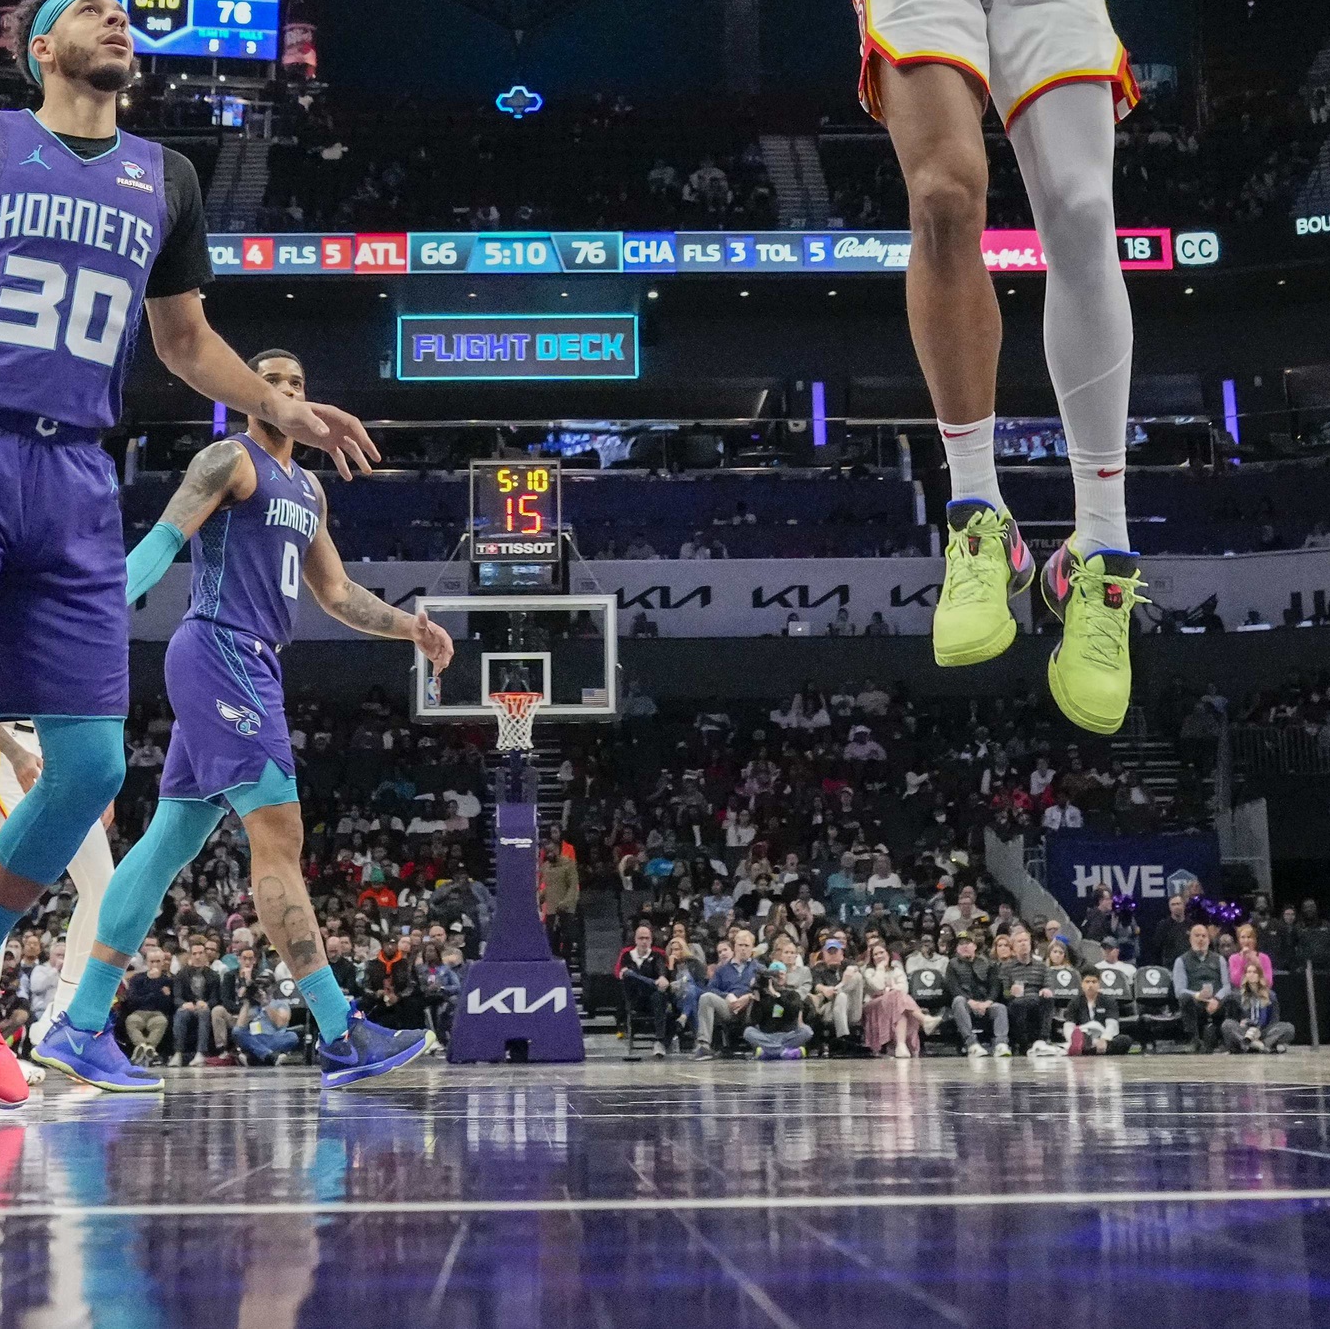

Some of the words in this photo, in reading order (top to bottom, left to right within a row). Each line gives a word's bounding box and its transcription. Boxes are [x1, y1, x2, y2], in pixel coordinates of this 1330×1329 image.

[217, 1, 251, 24] 76
[246, 245, 264, 264] 4
[279, 247, 317, 264] FLS
[325, 245, 342, 264] 5
[354, 243, 406, 266] ATL
[421, 243, 457, 265] 66
[484, 243, 546, 266] 5:10
[571, 241, 607, 264] 76
[623, 240, 675, 264] CHA
[683, 244, 721, 262] FLS
[730, 242, 746, 263] 3
[755, 243, 798, 262] TOL
[809, 242, 826, 263] 5
[834, 236, 888, 263] Bally
[1124, 238, 1151, 259] 18
[1182, 238, 1213, 260] CC
[412, 333, 529, 362] FLIGHT
[536, 333, 624, 361] DECK
[497, 469, 549, 492] 5:10
[265, 498, 318, 543] HORNETS
[505, 495, 542, 534] 15
[500, 542, 555, 555] TISSOT
[281, 541, 298, 599] 0
[1072, 865, 1165, 898] HIVE
